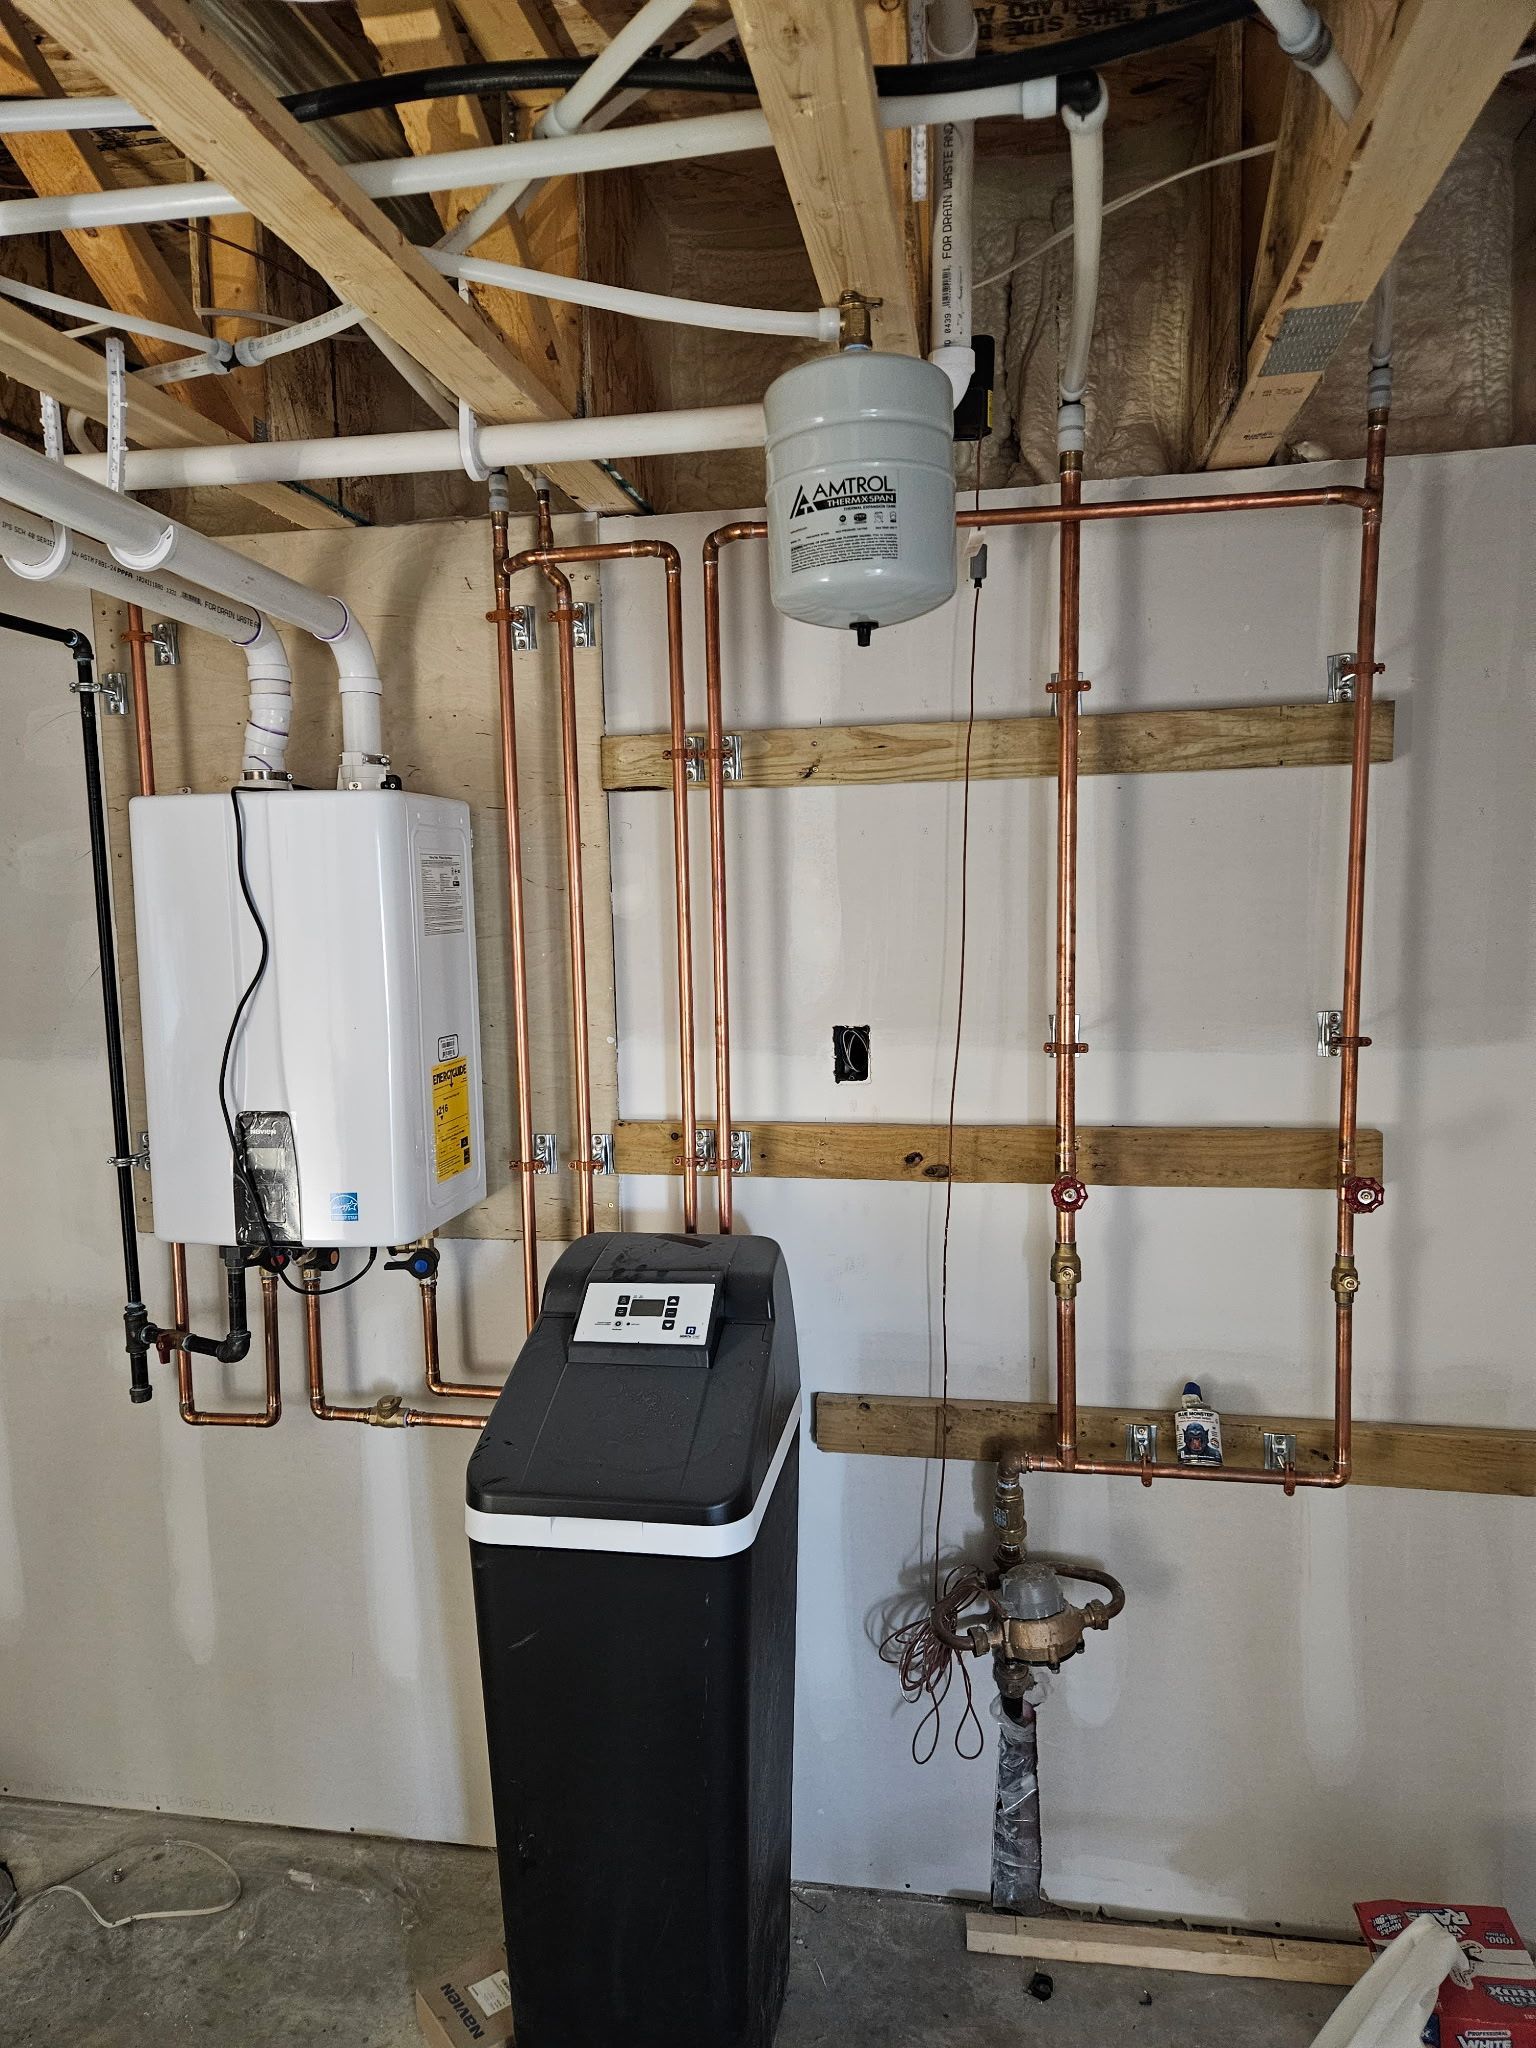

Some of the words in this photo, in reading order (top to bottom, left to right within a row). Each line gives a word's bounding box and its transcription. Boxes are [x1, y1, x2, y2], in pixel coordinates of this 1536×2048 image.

[942, 151, 954, 190] WASTE
[942, 194, 953, 233] DRAIN
[942, 236, 952, 260] FOR
[812, 475, 894, 501] AMTROL
[204, 600, 217, 613] FOR
[216, 606, 235, 620] DRAIN
[236, 615, 254, 628] WASTE
[1457, 2035, 1512, 2048] WHITE
